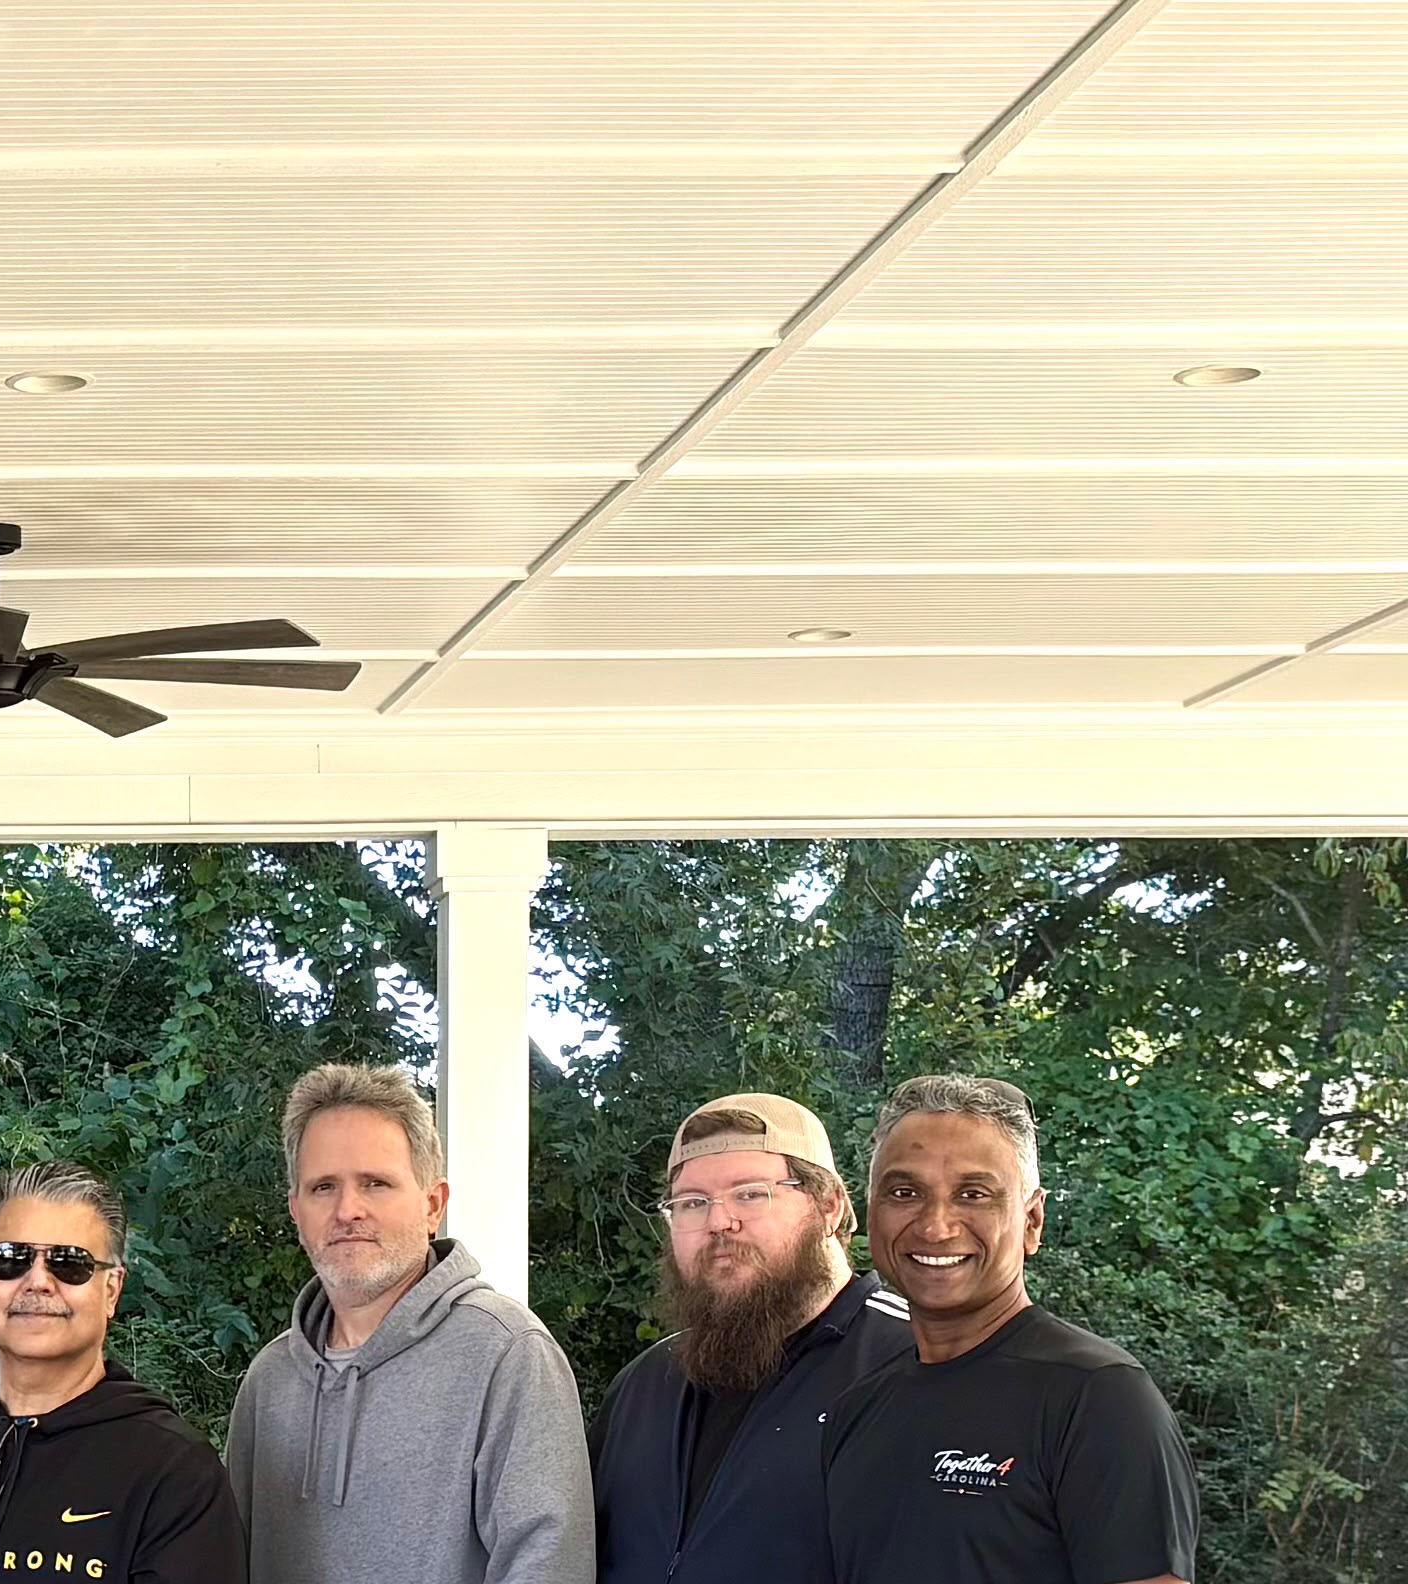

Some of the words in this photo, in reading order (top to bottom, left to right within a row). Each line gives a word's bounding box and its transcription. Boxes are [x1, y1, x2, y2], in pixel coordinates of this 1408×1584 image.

[934, 1450, 996, 1474] Together
[996, 1457, 1015, 1476] 4
[935, 1472, 997, 1487] CAROLINA
